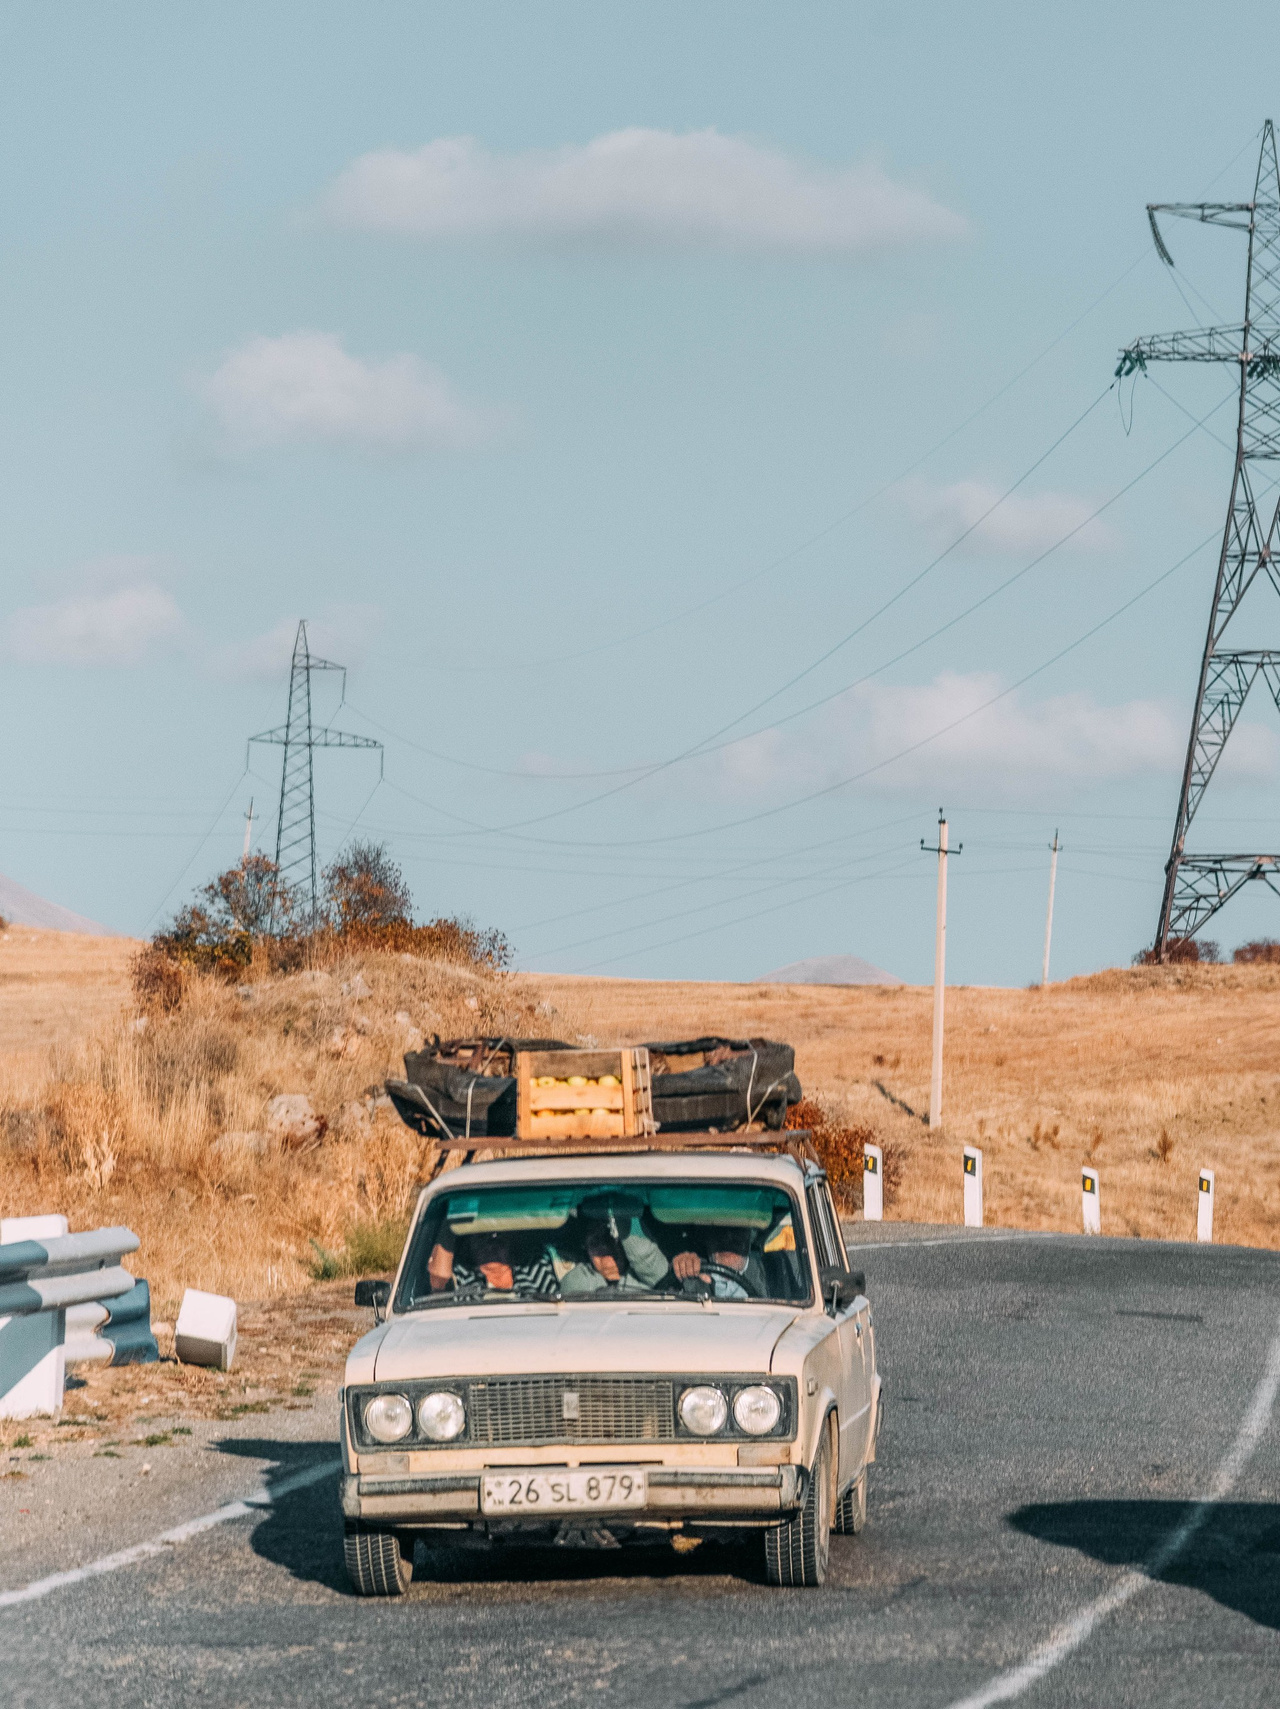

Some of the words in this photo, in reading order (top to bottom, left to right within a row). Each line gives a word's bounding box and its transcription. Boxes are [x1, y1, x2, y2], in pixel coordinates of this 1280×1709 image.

[508, 1479, 541, 1505] 26
[550, 1482, 578, 1503] SL
[586, 1474, 634, 1502] 879
